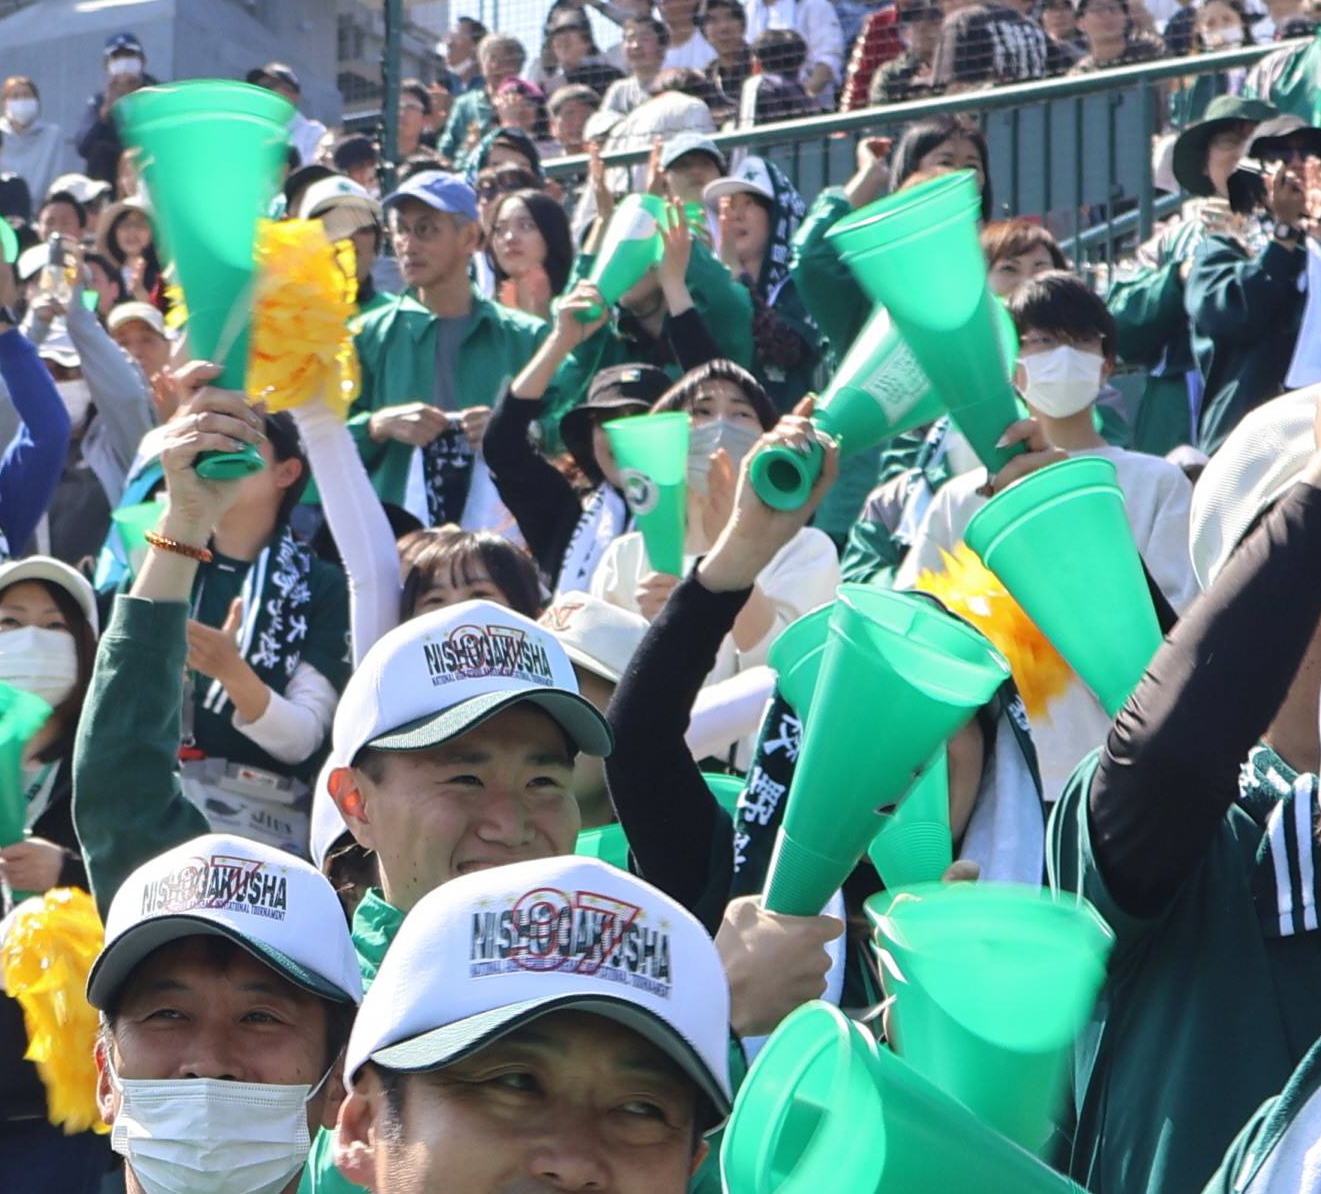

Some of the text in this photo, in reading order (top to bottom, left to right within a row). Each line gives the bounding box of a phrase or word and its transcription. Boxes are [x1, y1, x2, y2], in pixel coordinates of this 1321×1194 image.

[423, 634, 553, 680] NISHOGAKUSHA
[142, 867, 288, 915] NISHOGAKUSHA
[251, 904, 286, 922] TOURNAMENT
[470, 906, 673, 985] NISHOGAKUSHA
[511, 888, 643, 975] 97
